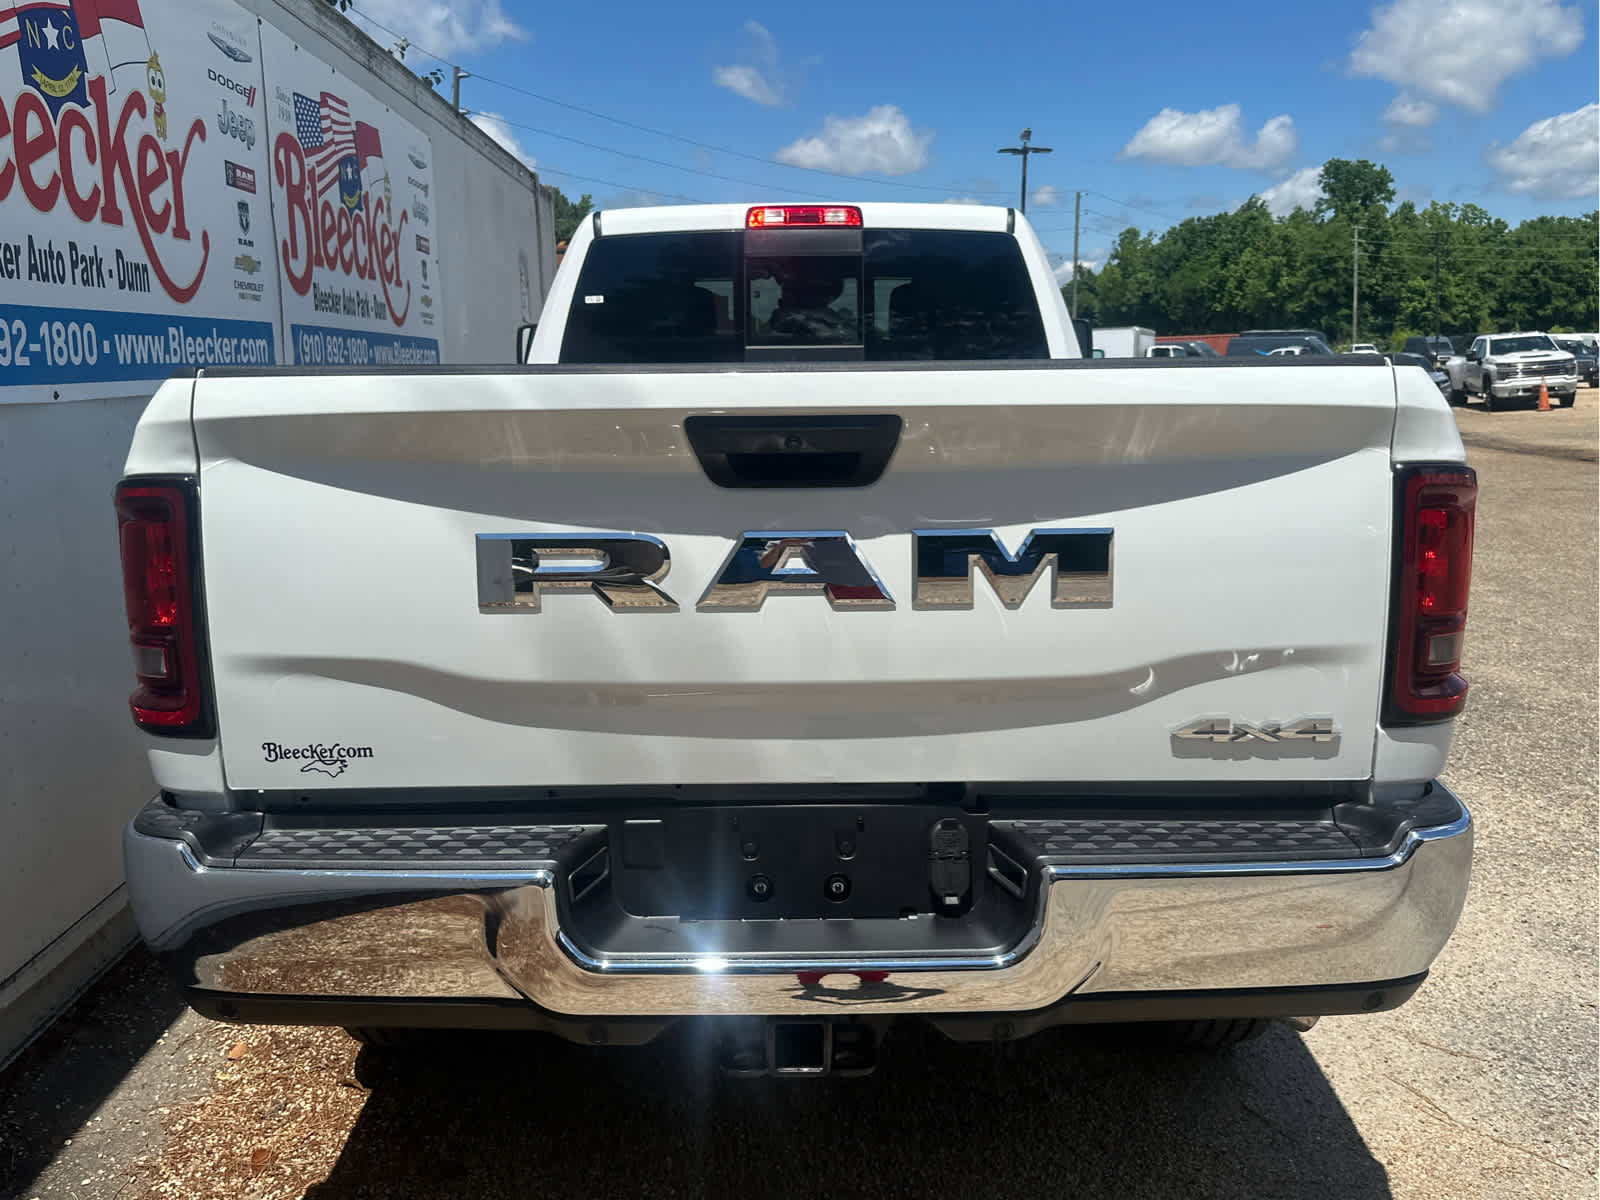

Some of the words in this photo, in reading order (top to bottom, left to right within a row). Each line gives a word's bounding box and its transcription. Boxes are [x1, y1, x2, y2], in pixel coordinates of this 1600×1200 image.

[207, 68, 250, 98] DODGE
[217, 99, 256, 151] Jeep
[237, 238, 255, 249] RAM
[274, 132, 410, 327] Bleecker
[28, 234, 66, 285] Auto
[68, 241, 106, 289] Park
[115, 248, 150, 292] Dunn
[313, 281, 342, 314] Bleecker
[114, 326, 270, 365] www.Bleecker.com
[299, 330, 325, 364] (910)
[326, 335, 368, 364] 892-1800
[475, 528, 1115, 614] RAM
